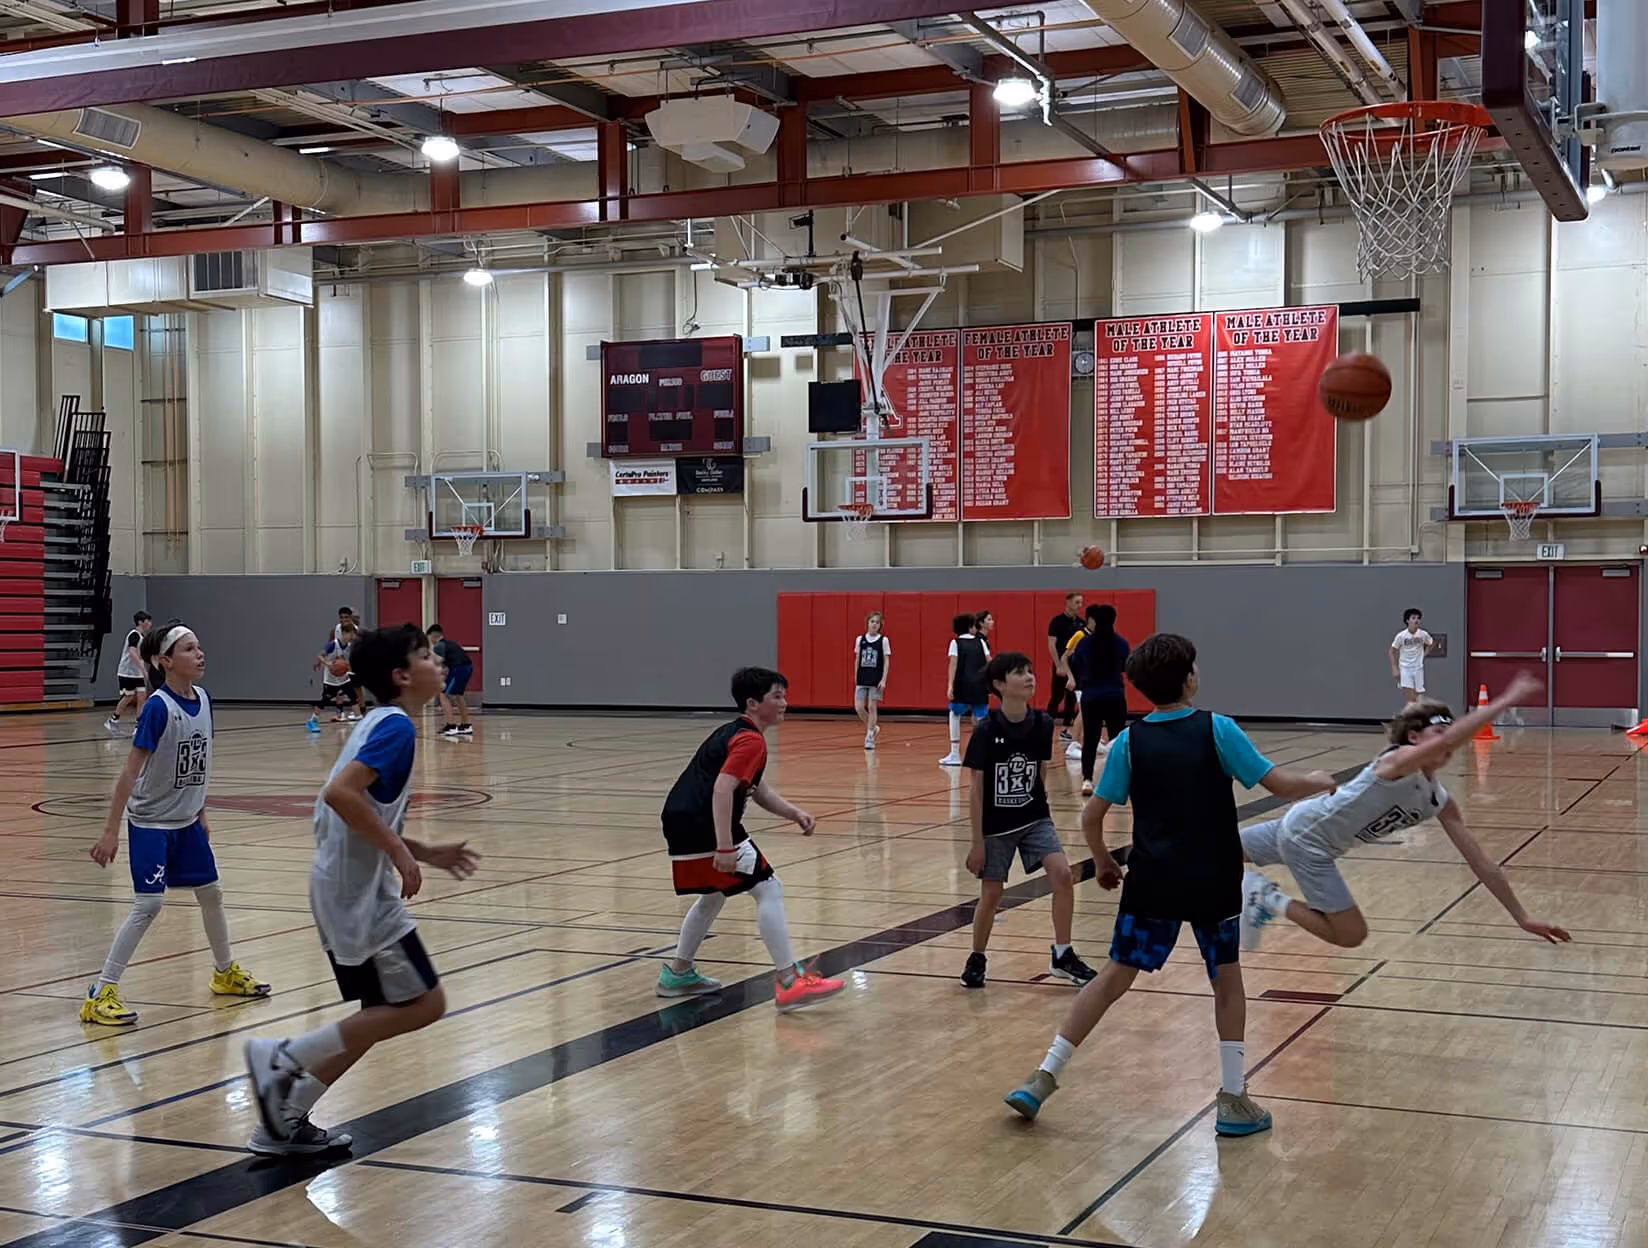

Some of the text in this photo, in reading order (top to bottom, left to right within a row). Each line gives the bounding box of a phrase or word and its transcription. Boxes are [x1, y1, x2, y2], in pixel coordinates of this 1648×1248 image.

[1106, 318, 1201, 337] MALE ATHLETE
[1226, 310, 1325, 330] MALE ATHLETE
[964, 326, 1069, 346] FEMALE ATHLETE
[1113, 334, 1194, 353] OF THE YEAR
[1233, 327, 1319, 345] OF THE YEAR
[911, 348, 943, 363] YEAR
[977, 342, 1055, 361] OF THE YEAR
[610, 374, 650, 385] ARAGON
[1542, 545, 1558, 558] EXIT
[491, 613, 504, 624] EXIT
